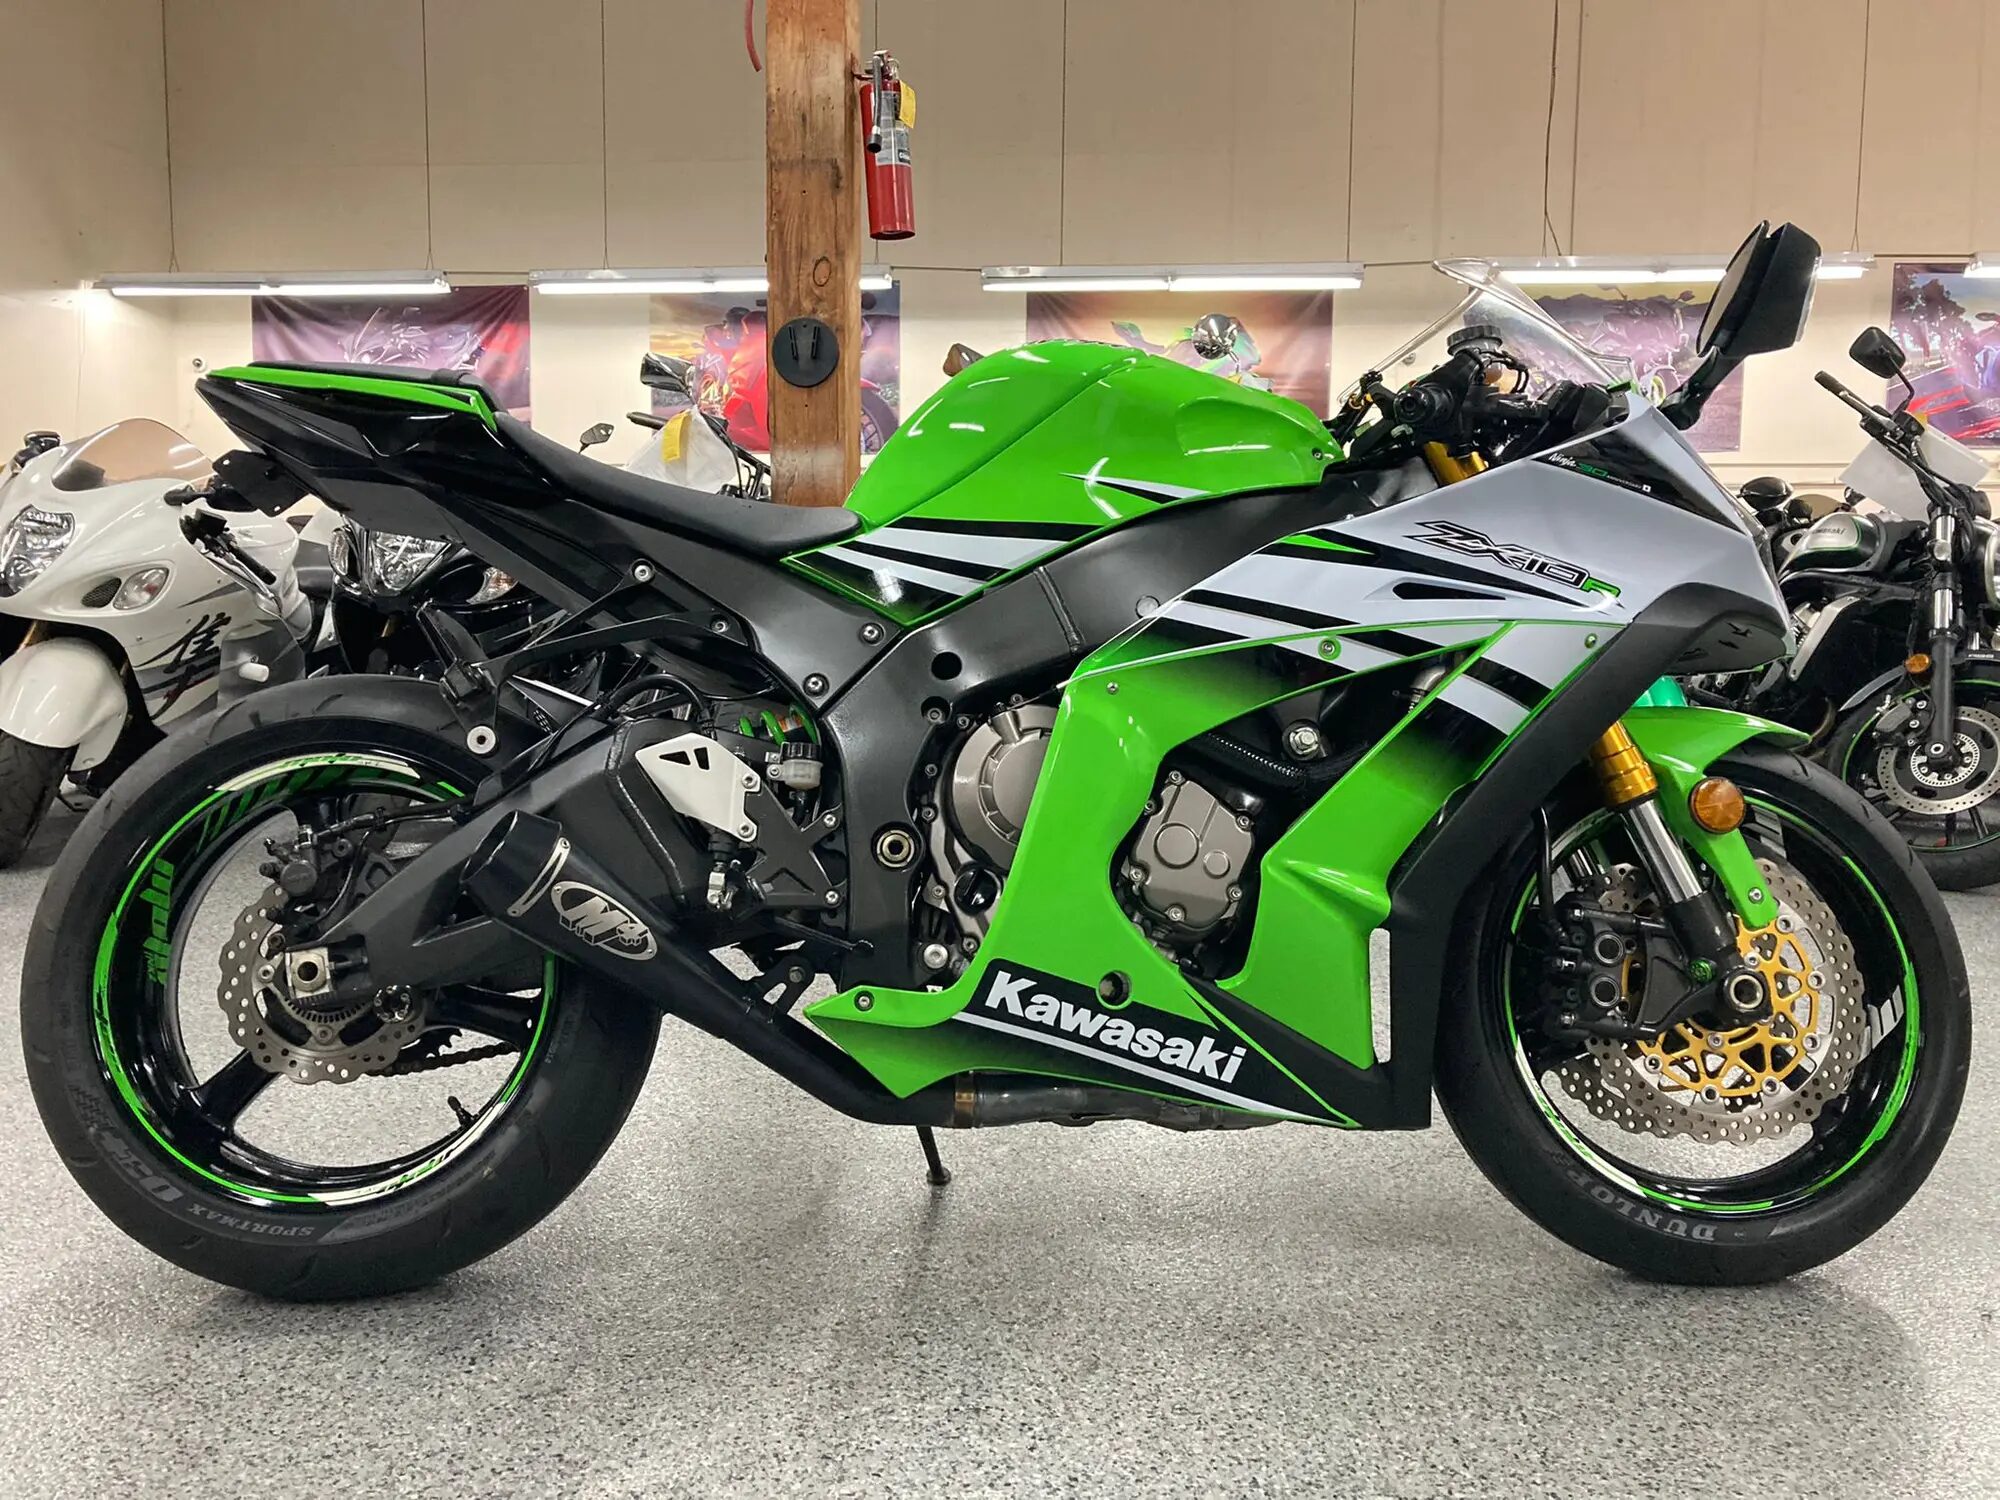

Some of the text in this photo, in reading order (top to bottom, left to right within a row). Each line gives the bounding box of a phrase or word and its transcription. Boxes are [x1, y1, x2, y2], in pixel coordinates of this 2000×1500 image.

[1549, 452, 1577, 467] Ninja
[1578, 462, 1609, 477] 30
[560, 895, 648, 947] M4
[985, 970, 1247, 1084] Kawasaki
[185, 1203, 315, 1237] SPORTMAX
[1565, 1168, 1718, 1242] DUNLOP
